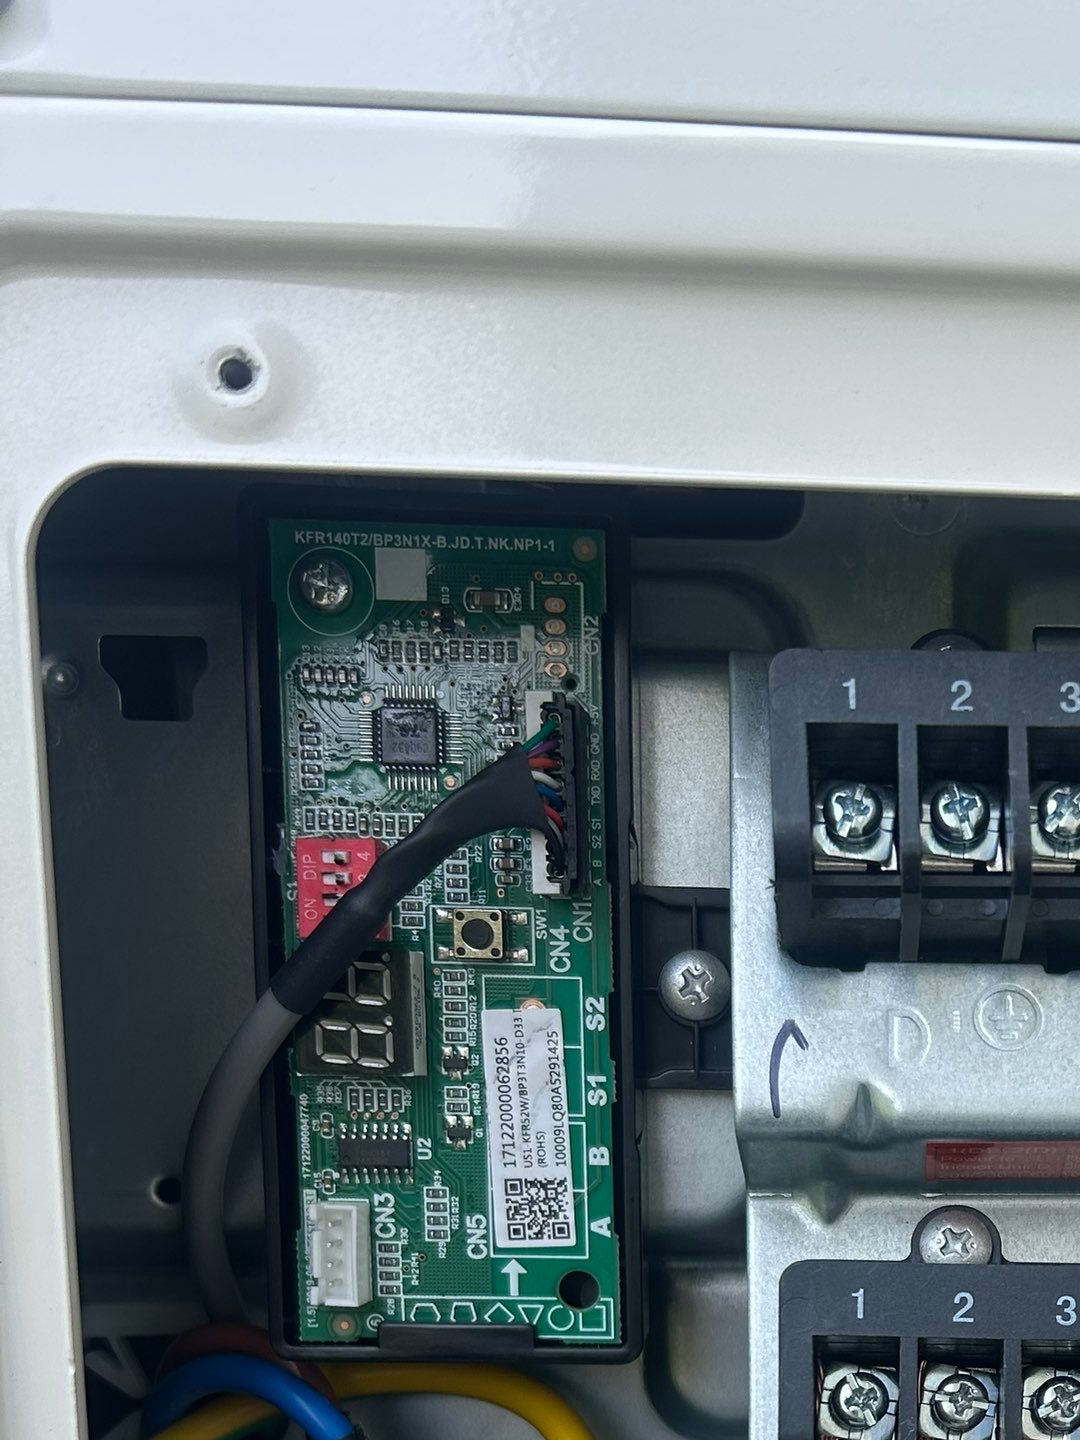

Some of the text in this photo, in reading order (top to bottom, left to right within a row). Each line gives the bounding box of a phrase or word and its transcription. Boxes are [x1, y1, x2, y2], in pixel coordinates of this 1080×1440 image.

[585, 615, 600, 656] CN2
[842, 678, 857, 710] 1
[950, 680, 974, 711] 2
[591, 732, 600, 755] GND
[591, 759, 600, 781] RXD
[591, 785, 601, 805] TXD
[592, 818, 601, 830] S1
[357, 851, 371, 862] 4
[592, 835, 602, 850] S2
[593, 859, 602, 868] B
[303, 854, 318, 921] ON DIP
[594, 878, 603, 887] A
[536, 909, 547, 940] SW1
[572, 902, 593, 942] CN1
[549, 925, 571, 973] CN4
[585, 996, 607, 1032] S2
[887, 1006, 932, 1068] D
[494, 1037, 517, 1168] 17122000062856
[586, 1074, 608, 1106] S1
[417, 1137, 432, 1161] U2
[536, 1131, 549, 1168] (ROHS)
[588, 1147, 610, 1166] B
[373, 1192, 397, 1239] CN3
[590, 1216, 613, 1239] A
[466, 1214, 488, 1260] CN5
[851, 1288, 1078, 1326] 1 2 3
